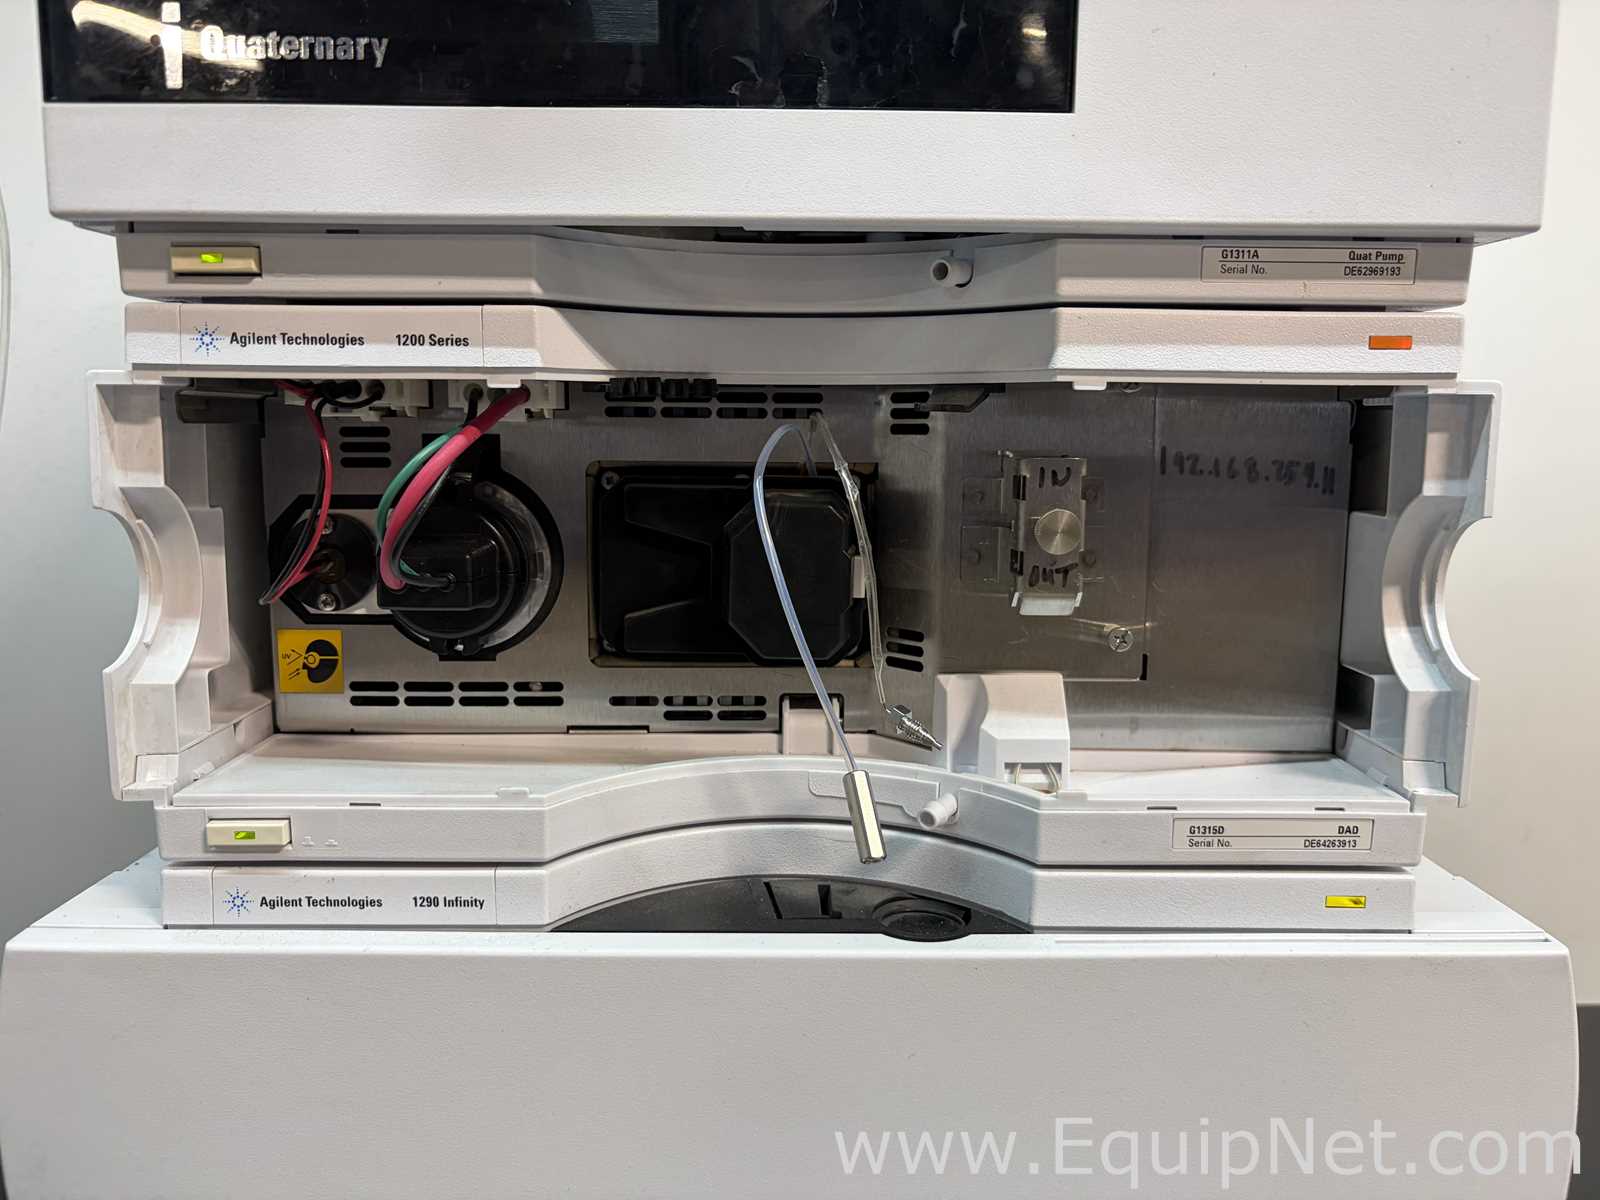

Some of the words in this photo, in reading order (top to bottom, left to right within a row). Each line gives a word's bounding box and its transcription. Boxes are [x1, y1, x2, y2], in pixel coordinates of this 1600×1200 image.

[200, 25, 389, 68] Quaternary
[1221, 248, 1260, 260] G1311A
[1348, 250, 1372, 262] Quat
[1375, 250, 1404, 264] Pump
[1219, 264, 1248, 275] Serial
[1251, 264, 1268, 275] No.
[1343, 266, 1401, 278] DE62969193
[229, 332, 277, 347] Agilent
[280, 333, 365, 349] Technologies
[395, 334, 426, 347] 1200
[428, 334, 470, 348] Series
[1189, 825, 1225, 836] G1315D
[1337, 825, 1359, 836] DAD
[1188, 838, 1214, 848] Serial
[1217, 838, 1233, 848] No.
[1303, 839, 1358, 849] DE64263913
[259, 895, 303, 910] Agilent
[305, 896, 384, 911] Technologies
[412, 896, 440, 908] 1290
[442, 896, 485, 910] Infinity
